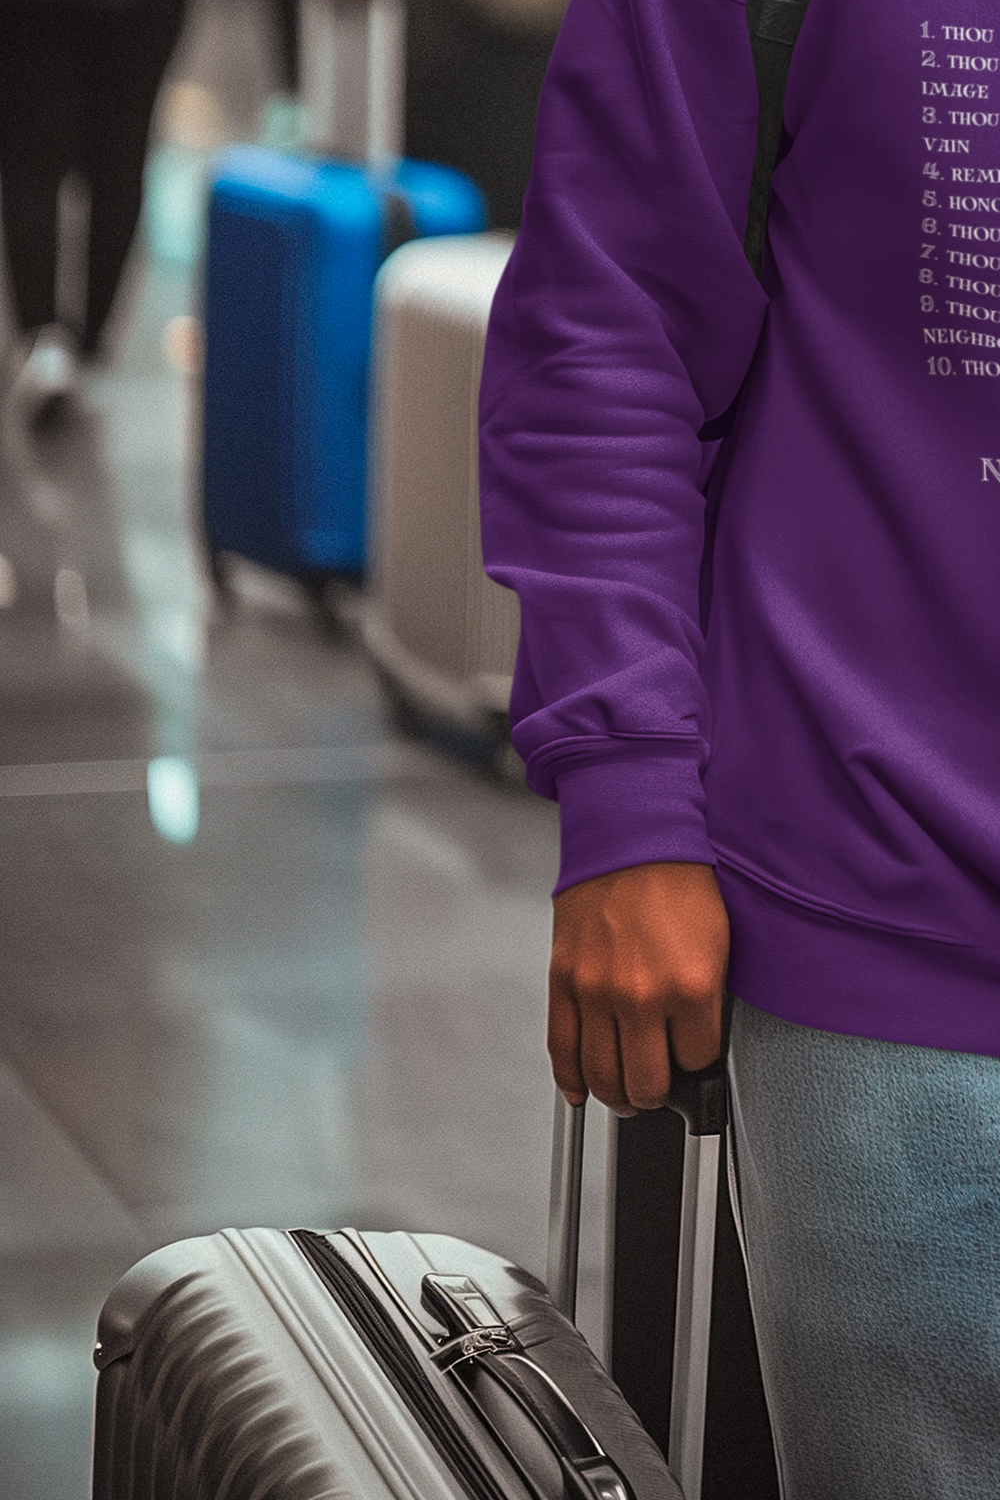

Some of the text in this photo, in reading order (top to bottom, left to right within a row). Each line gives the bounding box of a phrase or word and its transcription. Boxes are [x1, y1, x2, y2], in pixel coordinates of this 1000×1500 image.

[920, 21, 935, 39] 1.
[941, 25, 994, 43] THOU
[921, 50, 940, 68] 2.
[947, 54, 999, 71] THOU
[922, 81, 988, 99] IMAGE
[922, 106, 942, 124] 3.
[948, 111, 1000, 126] THOU
[923, 137, 970, 153] VAIN
[923, 162, 944, 180] 4.
[922, 190, 941, 208] 5.
[922, 217, 941, 235] 6.
[921, 243, 938, 260] 7.
[919, 268, 937, 285] 8.
[920, 295, 939, 312] 9.
[927, 356, 956, 376] 10.
